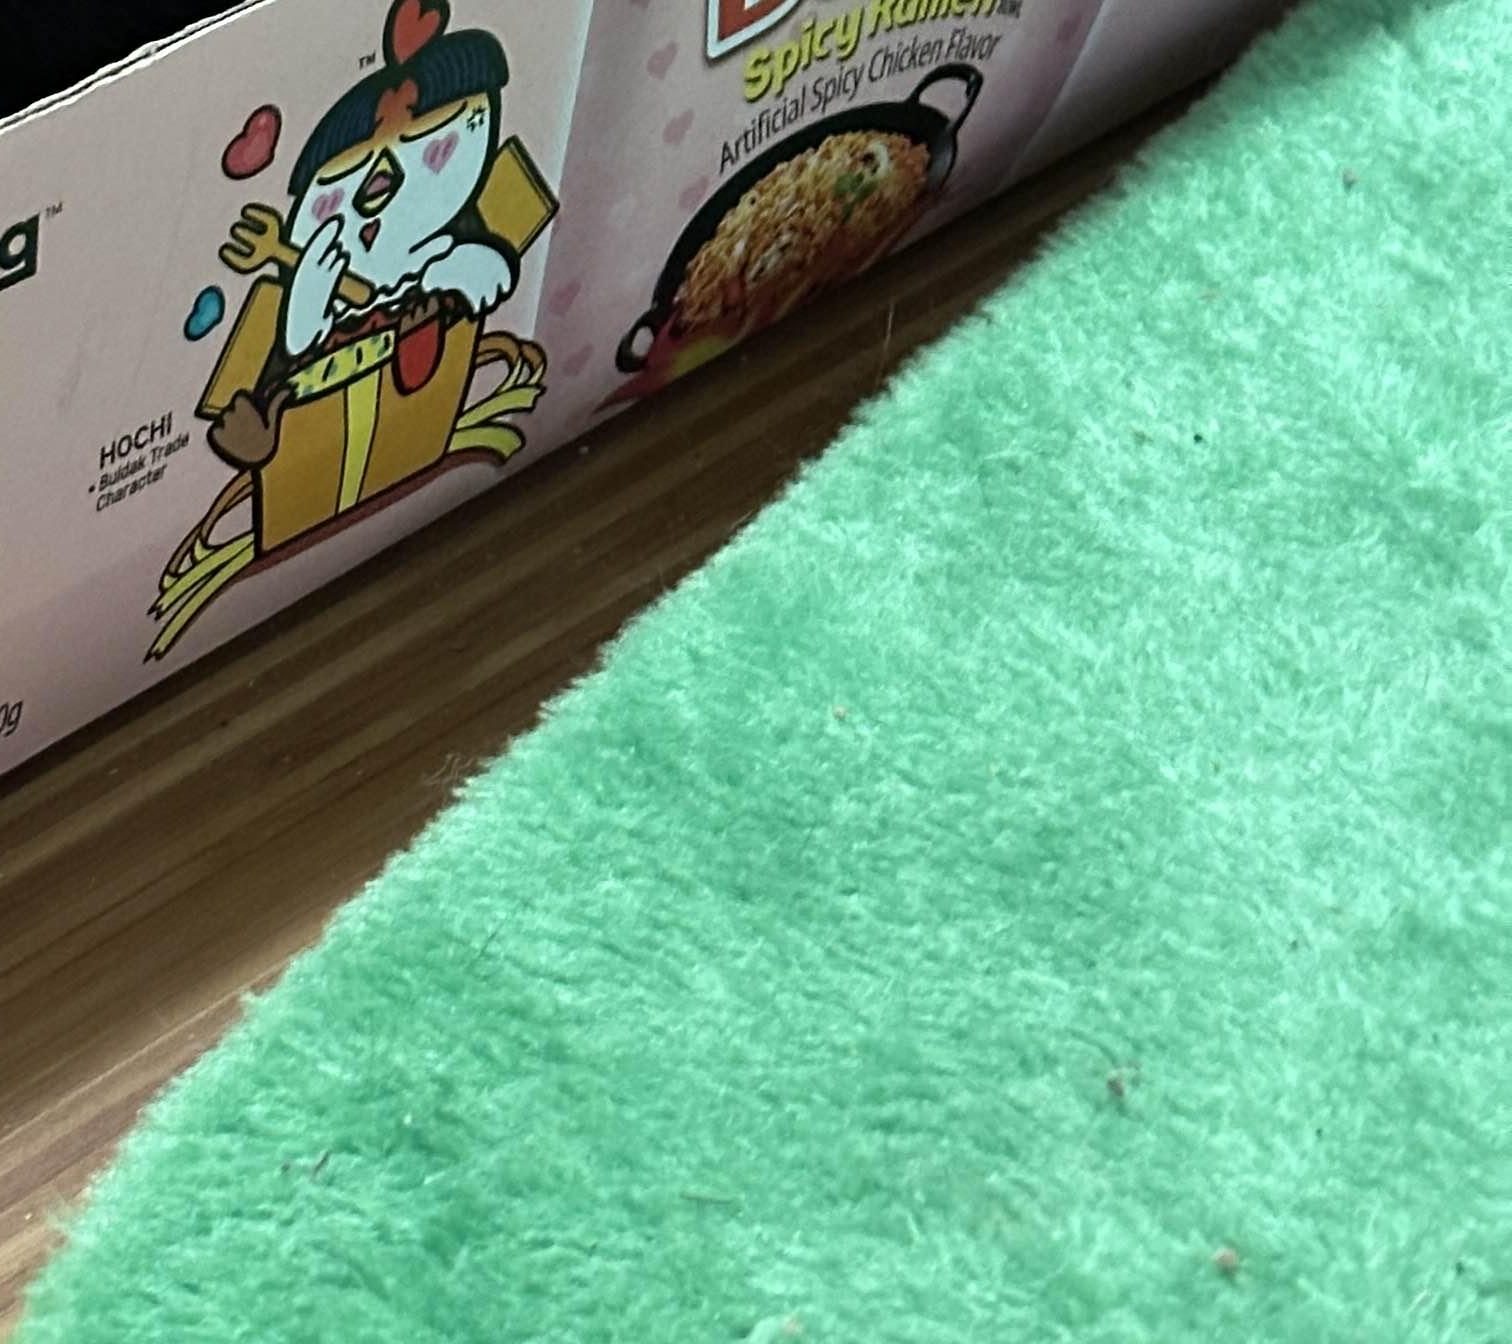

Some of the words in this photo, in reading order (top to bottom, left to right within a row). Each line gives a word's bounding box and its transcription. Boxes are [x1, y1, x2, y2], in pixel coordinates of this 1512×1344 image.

[743, 4, 865, 103] Spicy
[719, 81, 806, 174] Artificial
[810, 64, 864, 113] Spicy
[868, 36, 944, 84] Chicken
[945, 27, 1002, 62] Flavor
[99, 456, 146, 492] Buldak
[150, 433, 190, 465] Trade
[100, 411, 172, 470] HOCHI
[96, 464, 168, 512] Character
